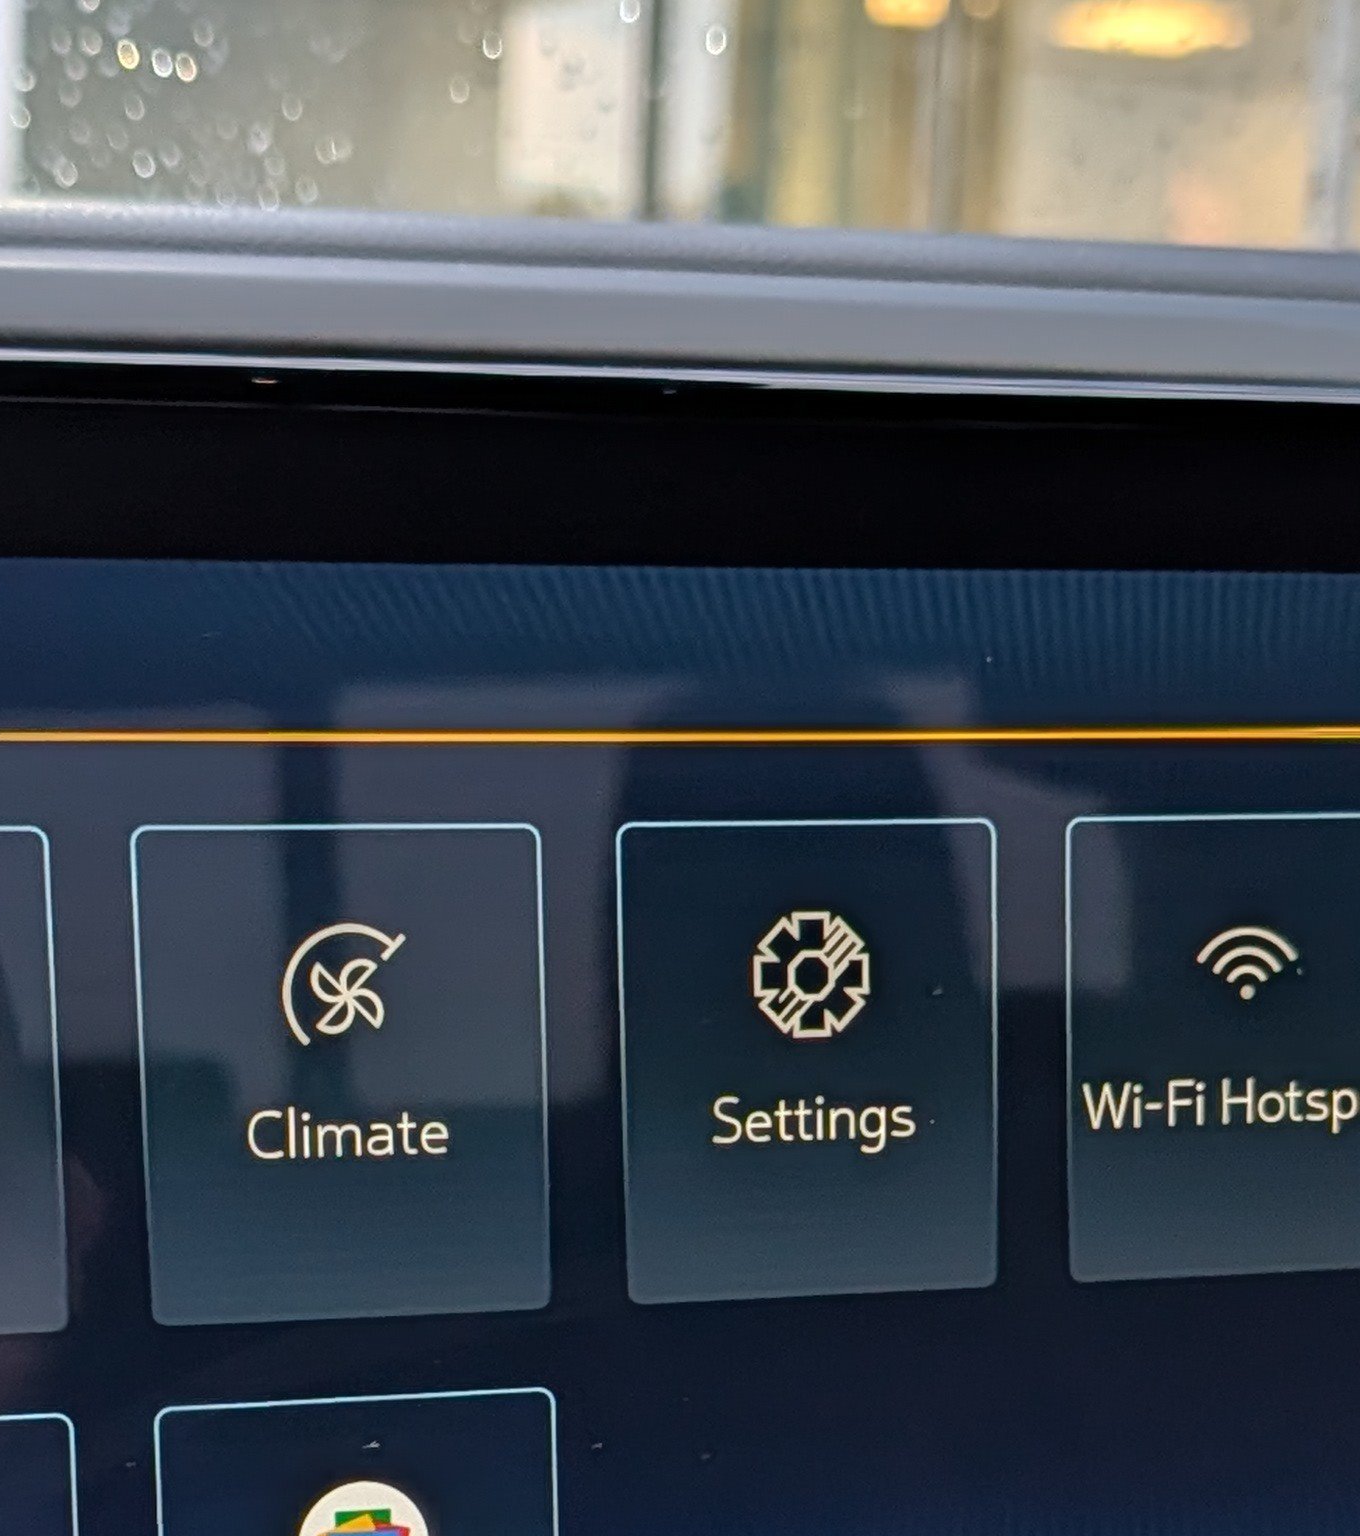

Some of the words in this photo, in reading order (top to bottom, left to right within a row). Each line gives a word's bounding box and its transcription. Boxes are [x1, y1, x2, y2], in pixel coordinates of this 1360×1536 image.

[711, 1094, 917, 1154] Settings
[1081, 1079, 1207, 1131] Wi-Fi
[246, 1107, 450, 1160] Climate
